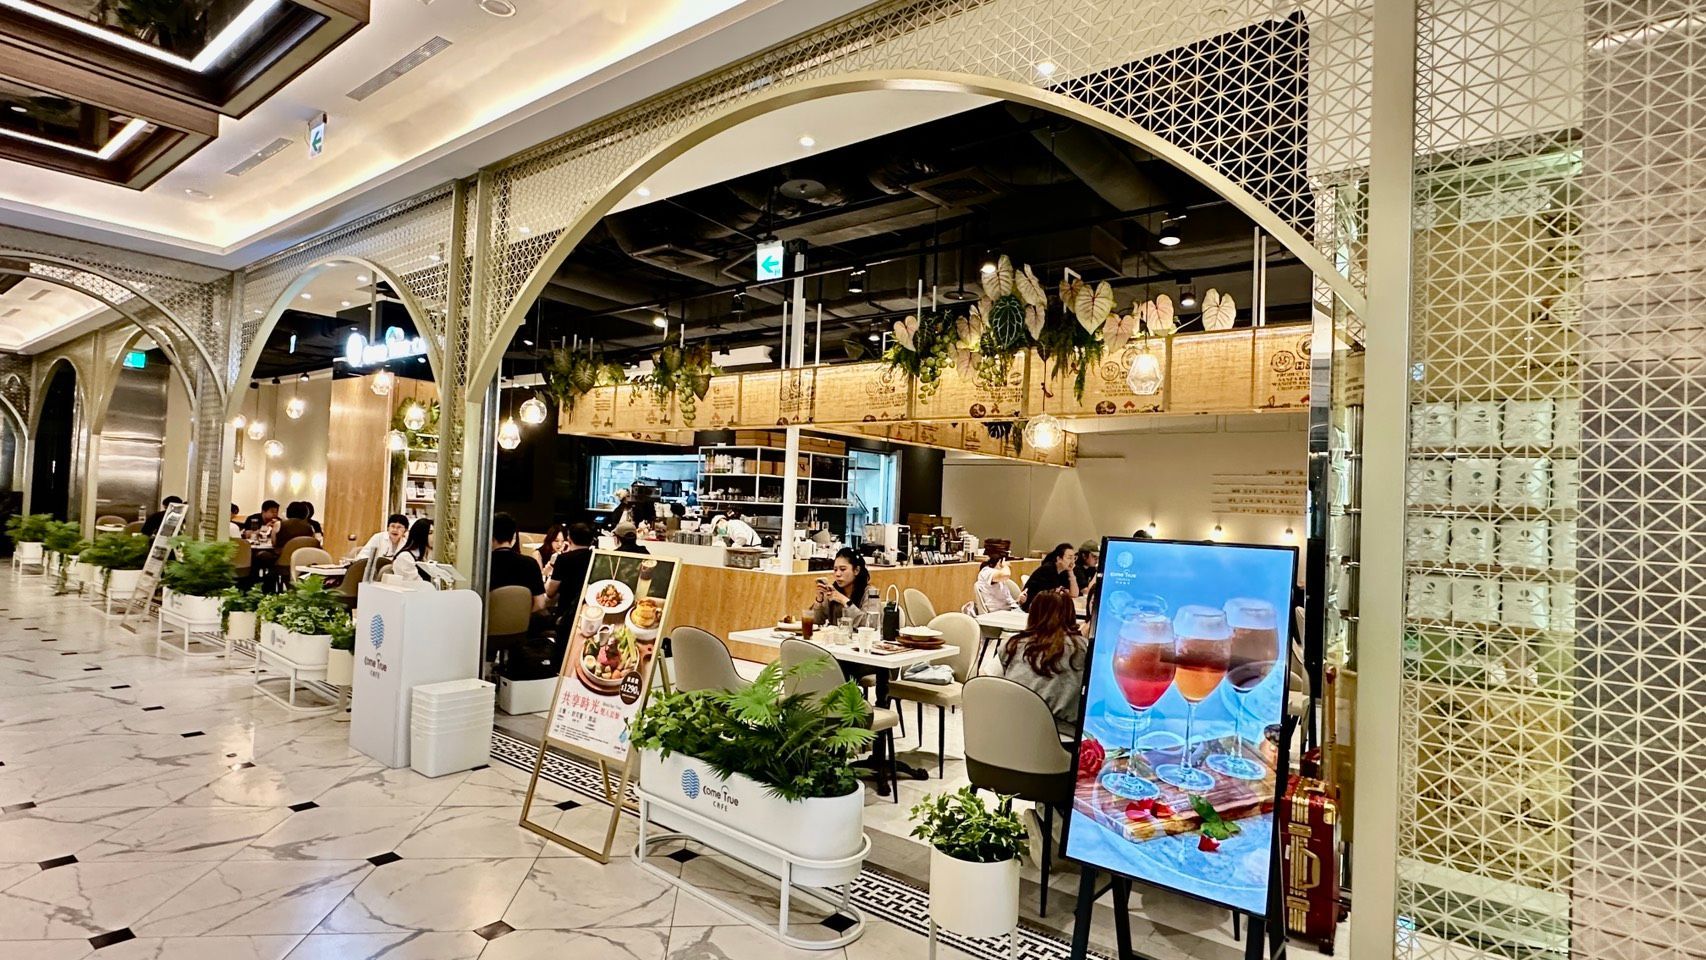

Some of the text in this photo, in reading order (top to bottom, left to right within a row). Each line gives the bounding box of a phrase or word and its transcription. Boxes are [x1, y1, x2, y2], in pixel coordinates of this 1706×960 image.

[562, 690, 600, 714] 共享時光
[703, 785, 739, 806] Come True
[713, 801, 728, 812] CAFE
